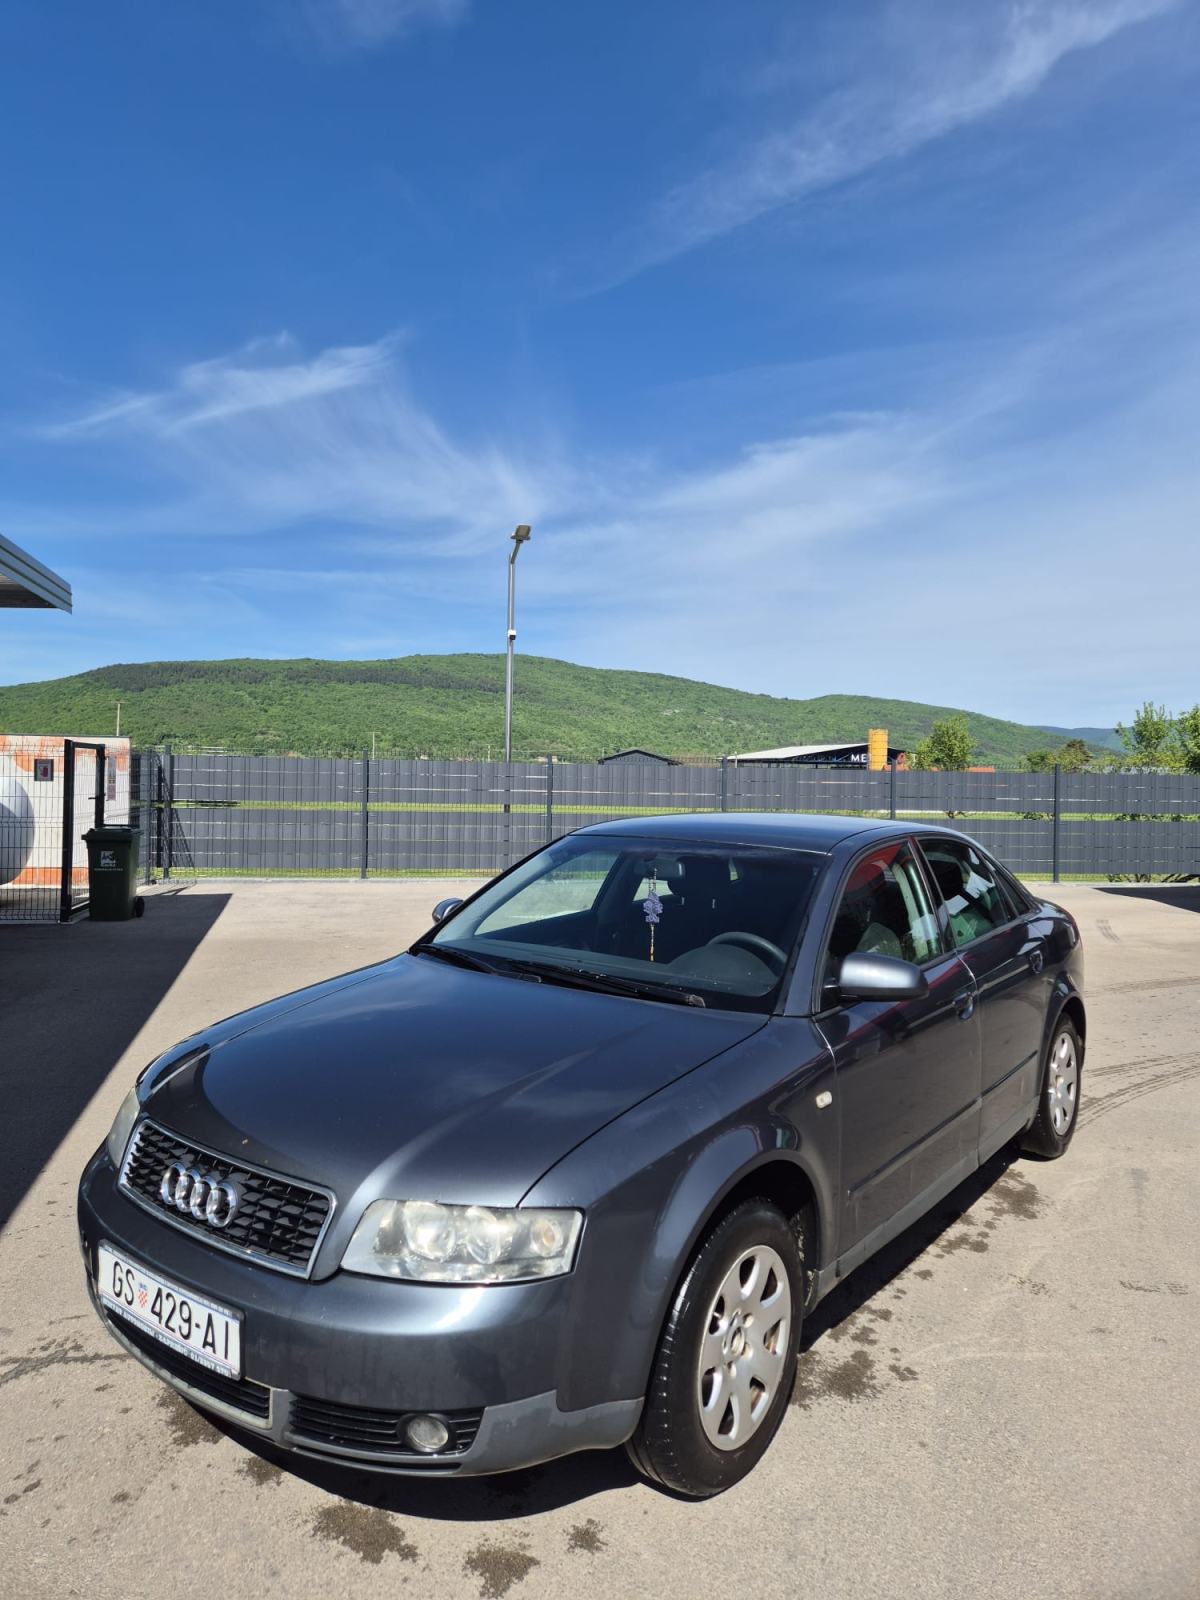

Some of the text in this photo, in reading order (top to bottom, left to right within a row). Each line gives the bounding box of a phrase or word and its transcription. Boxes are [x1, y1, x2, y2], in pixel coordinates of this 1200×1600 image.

[851, 753, 870, 763] ME
[112, 1260, 135, 1306] GS
[151, 1287, 229, 1360] 429-AI
